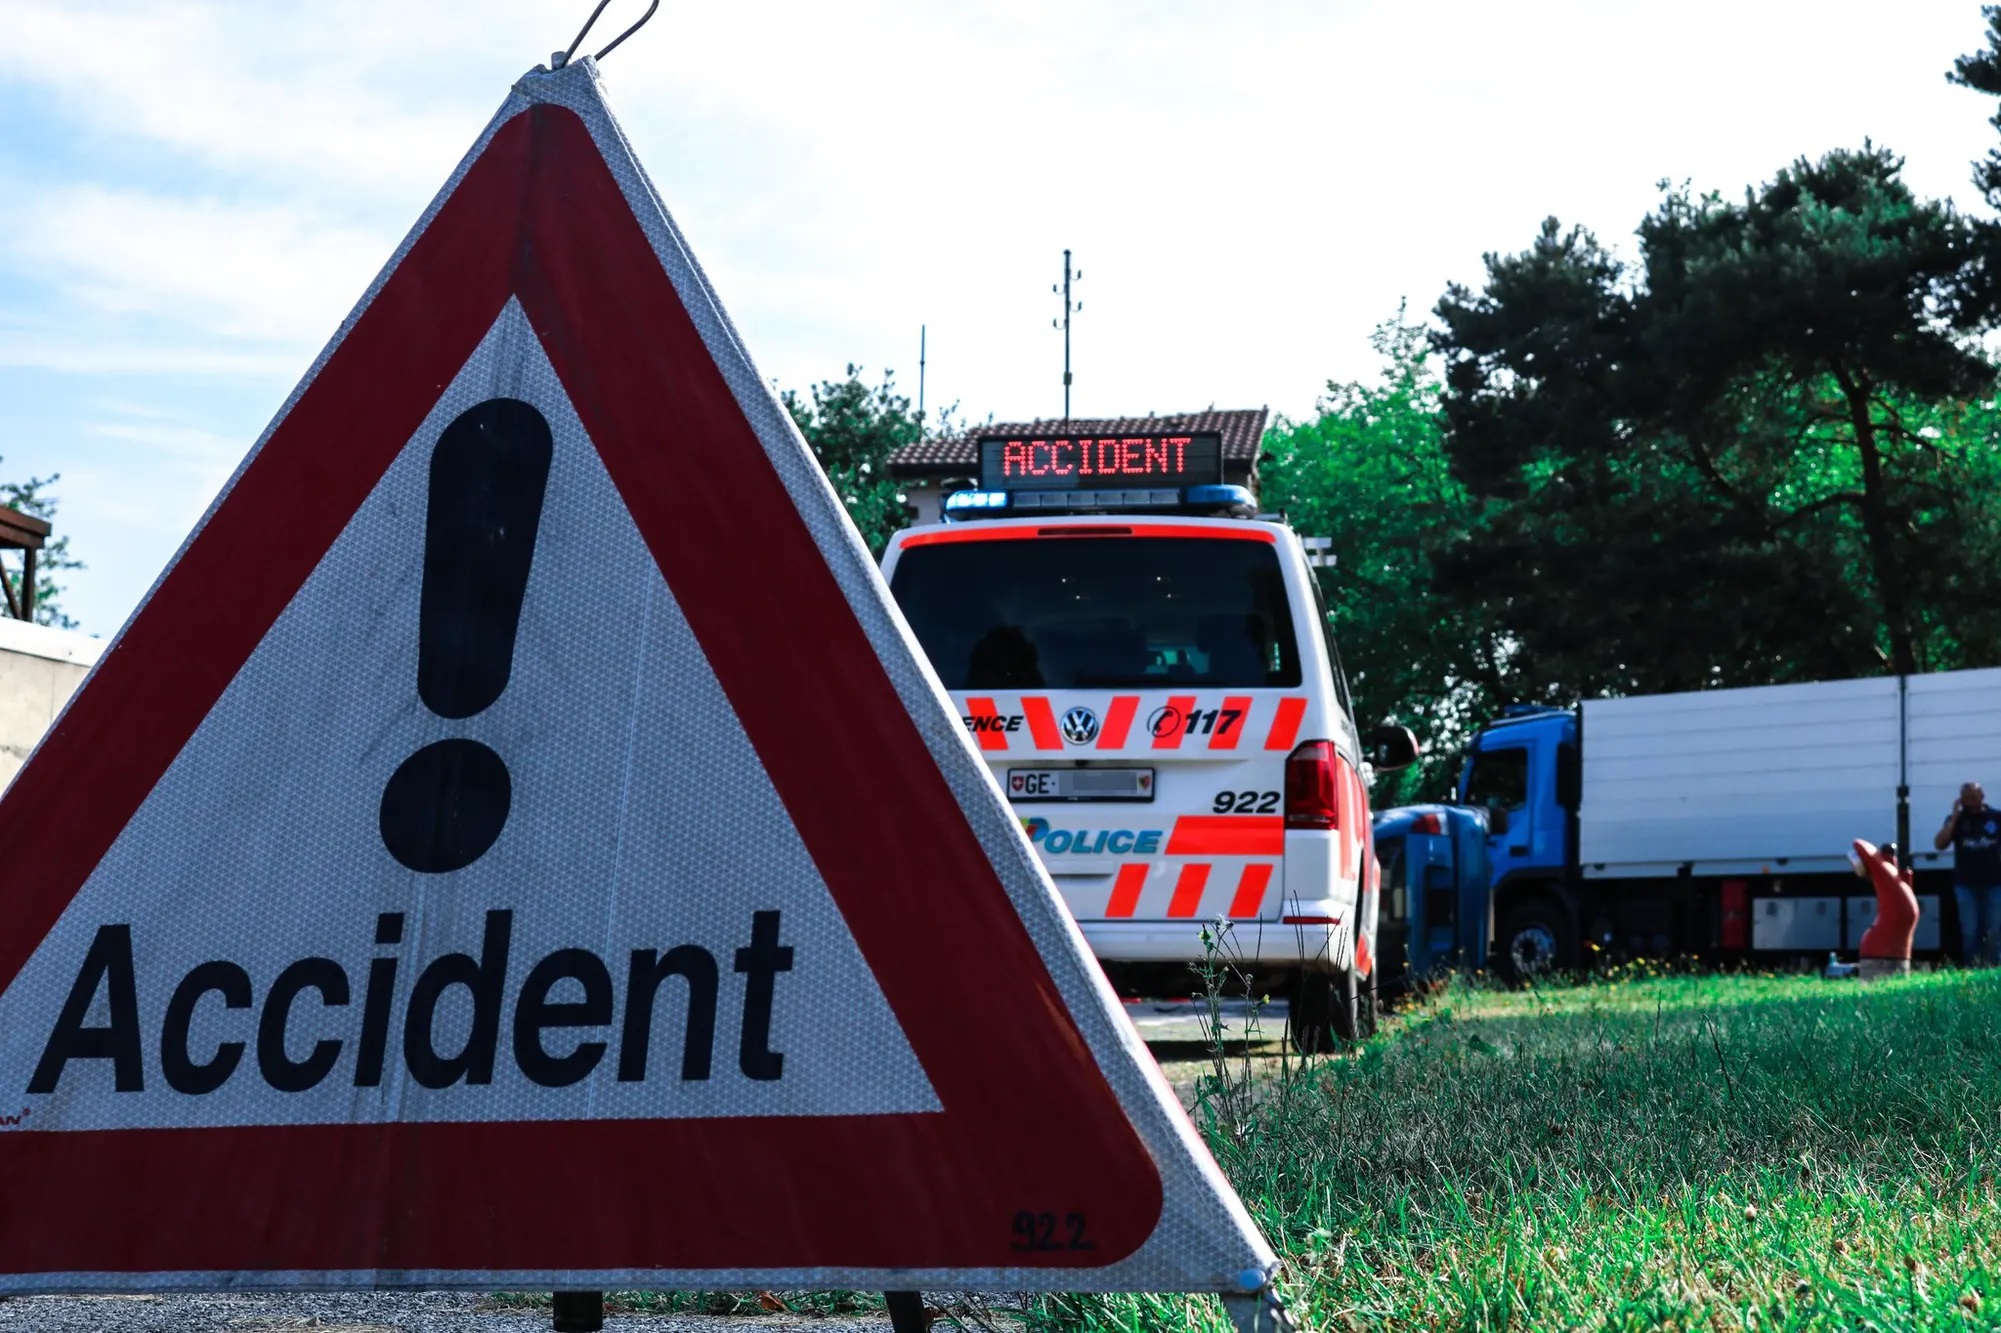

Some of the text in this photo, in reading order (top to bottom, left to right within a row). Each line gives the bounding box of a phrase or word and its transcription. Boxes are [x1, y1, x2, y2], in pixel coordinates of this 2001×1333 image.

[1004, 438, 1192, 476] ACCIDENT
[1184, 709, 1242, 735] 117
[1212, 791, 1281, 814] 922
[1021, 817, 1163, 854] POLICE
[26, 909, 794, 1095] Accident
[1010, 1211, 1095, 1252] 922
